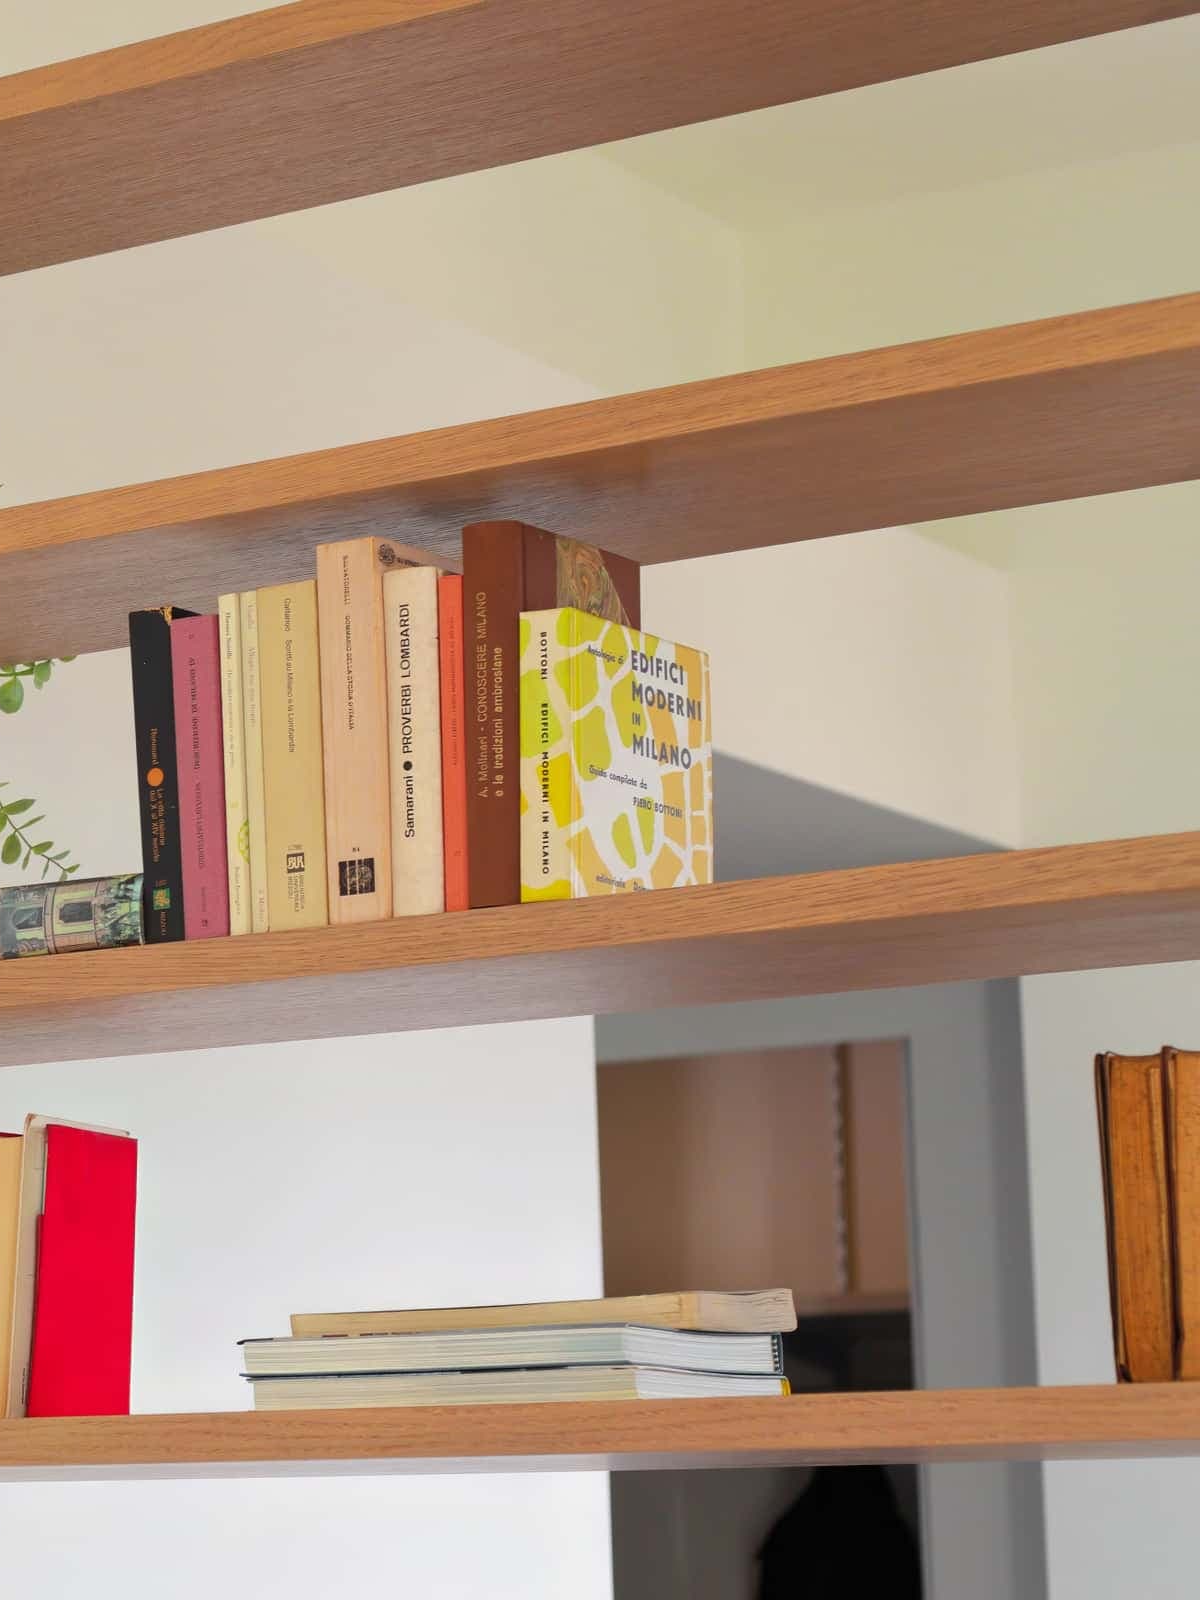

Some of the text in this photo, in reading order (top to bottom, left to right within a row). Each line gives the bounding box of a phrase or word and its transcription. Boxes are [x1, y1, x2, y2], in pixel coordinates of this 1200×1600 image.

[475, 591, 487, 639] MILANO
[476, 643, 487, 722] CONOSCERE
[492, 647, 503, 713] ambrosiane
[631, 650, 684, 685] EDIFICI
[399, 603, 415, 838] Samarani PROVERBI LOMBARDI
[632, 681, 702, 721] MODERNI
[632, 711, 641, 726] IN
[476, 736, 488, 782] Molinari
[492, 718, 504, 769] tradizioni
[540, 631, 550, 874] BOTTONI EDIFICI MODERNI IN MILANO
[633, 733, 692, 769] MILANO
[632, 796, 683, 818] PIERO BOTTONI
[287, 856, 304, 870] BUR
